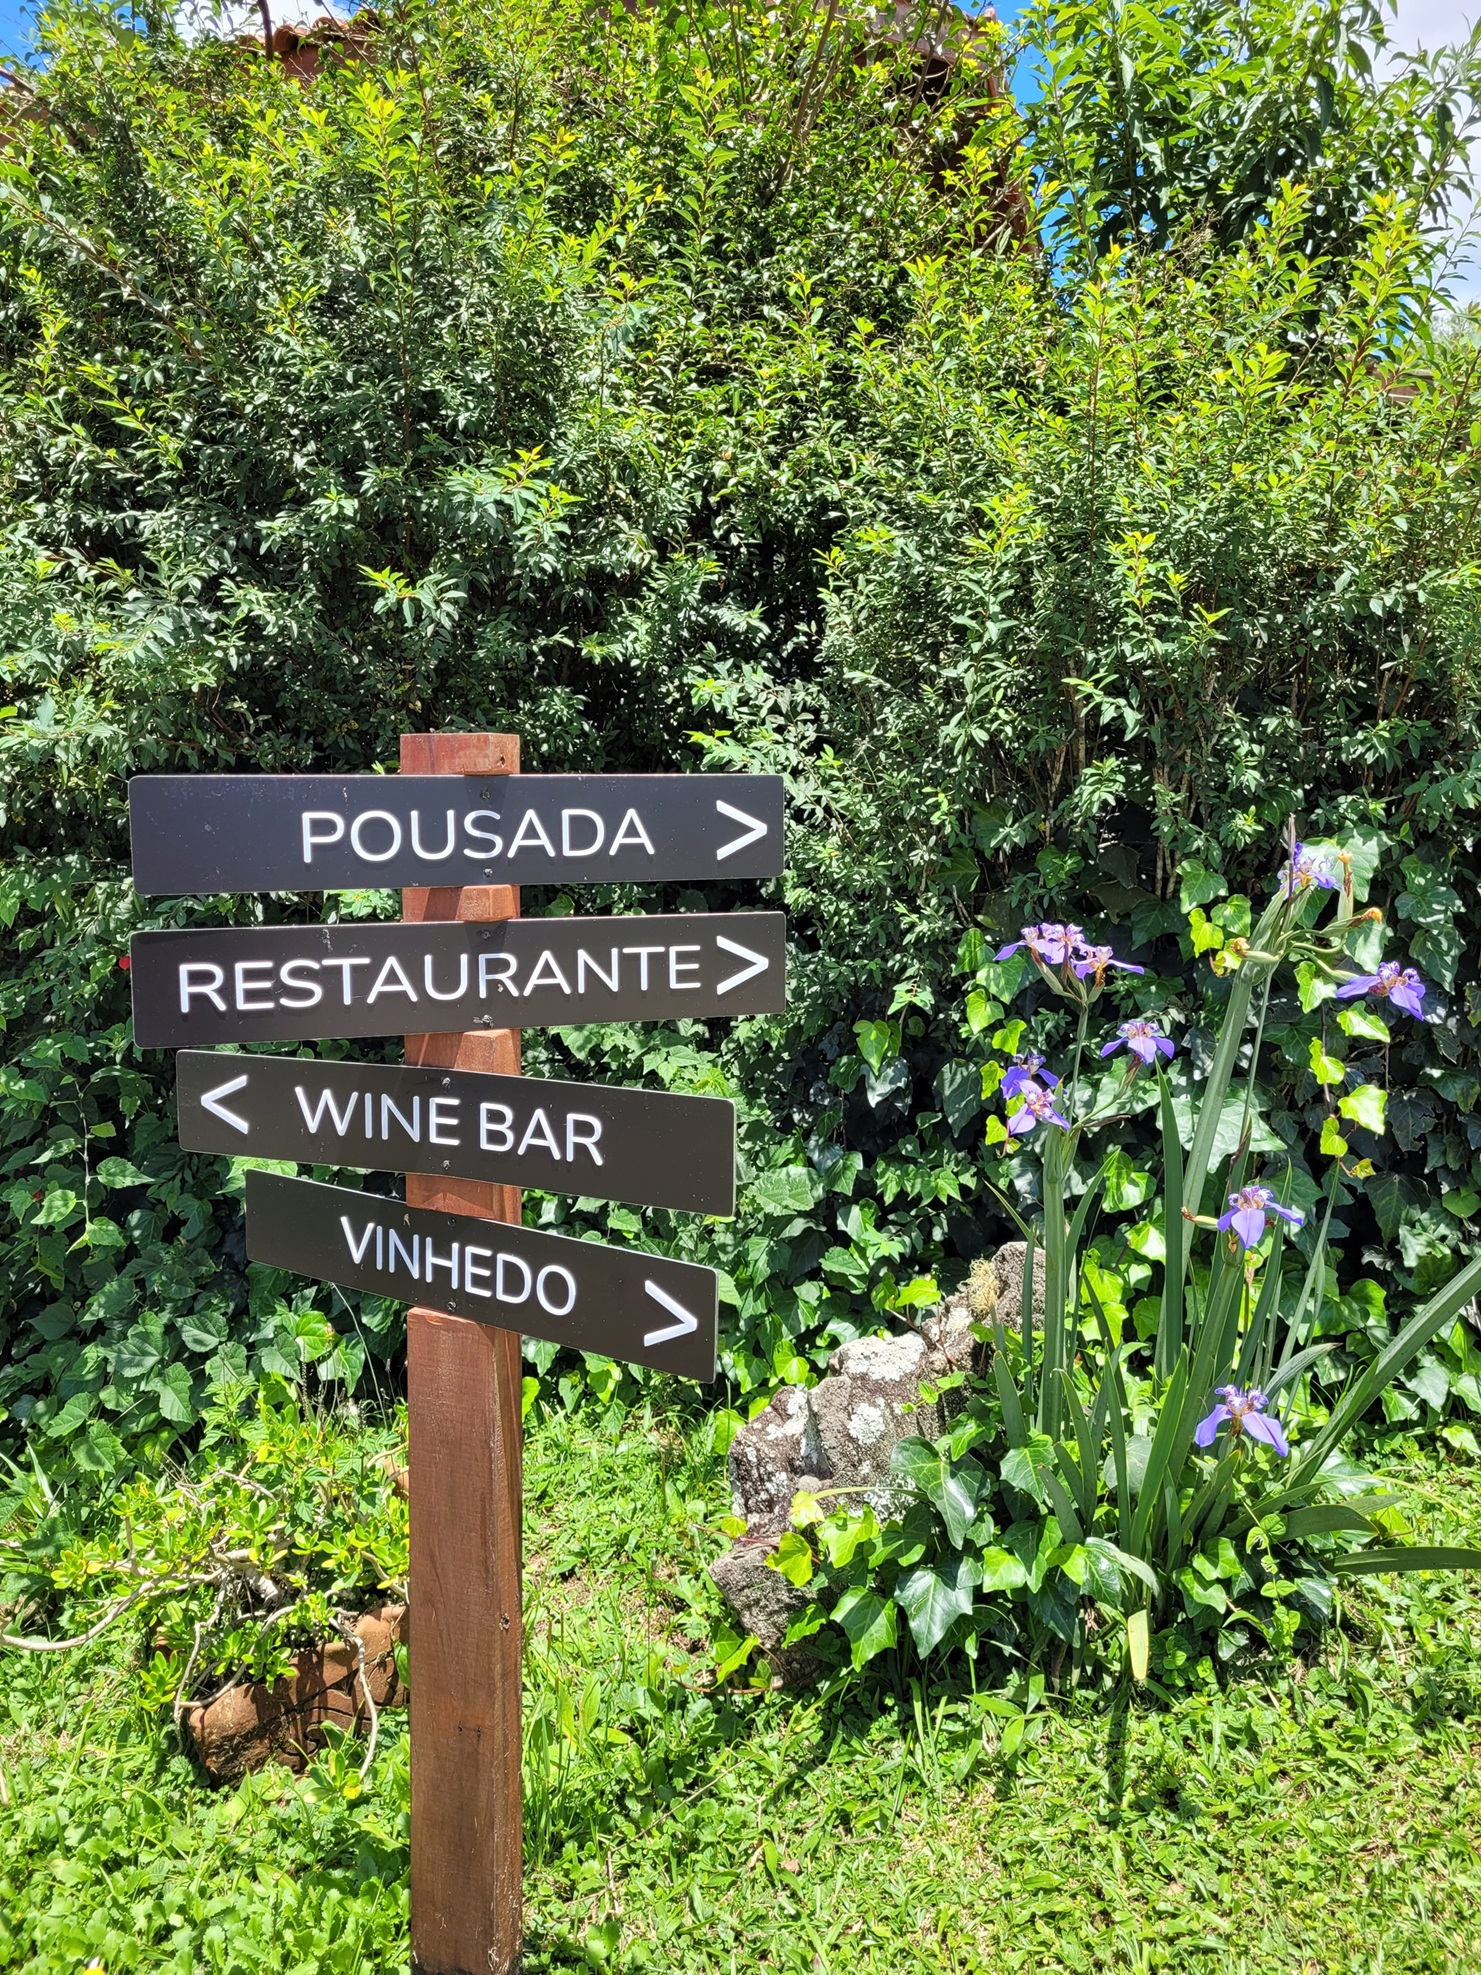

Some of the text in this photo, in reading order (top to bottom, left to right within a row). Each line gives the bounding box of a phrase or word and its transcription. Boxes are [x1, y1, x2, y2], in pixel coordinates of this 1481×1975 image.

[300, 807, 656, 865] POUSADA
[178, 944, 702, 1014] RESTAURANTE
[294, 1085, 605, 1167] WINE BAR
[340, 1215, 577, 1317] VINHEDO
